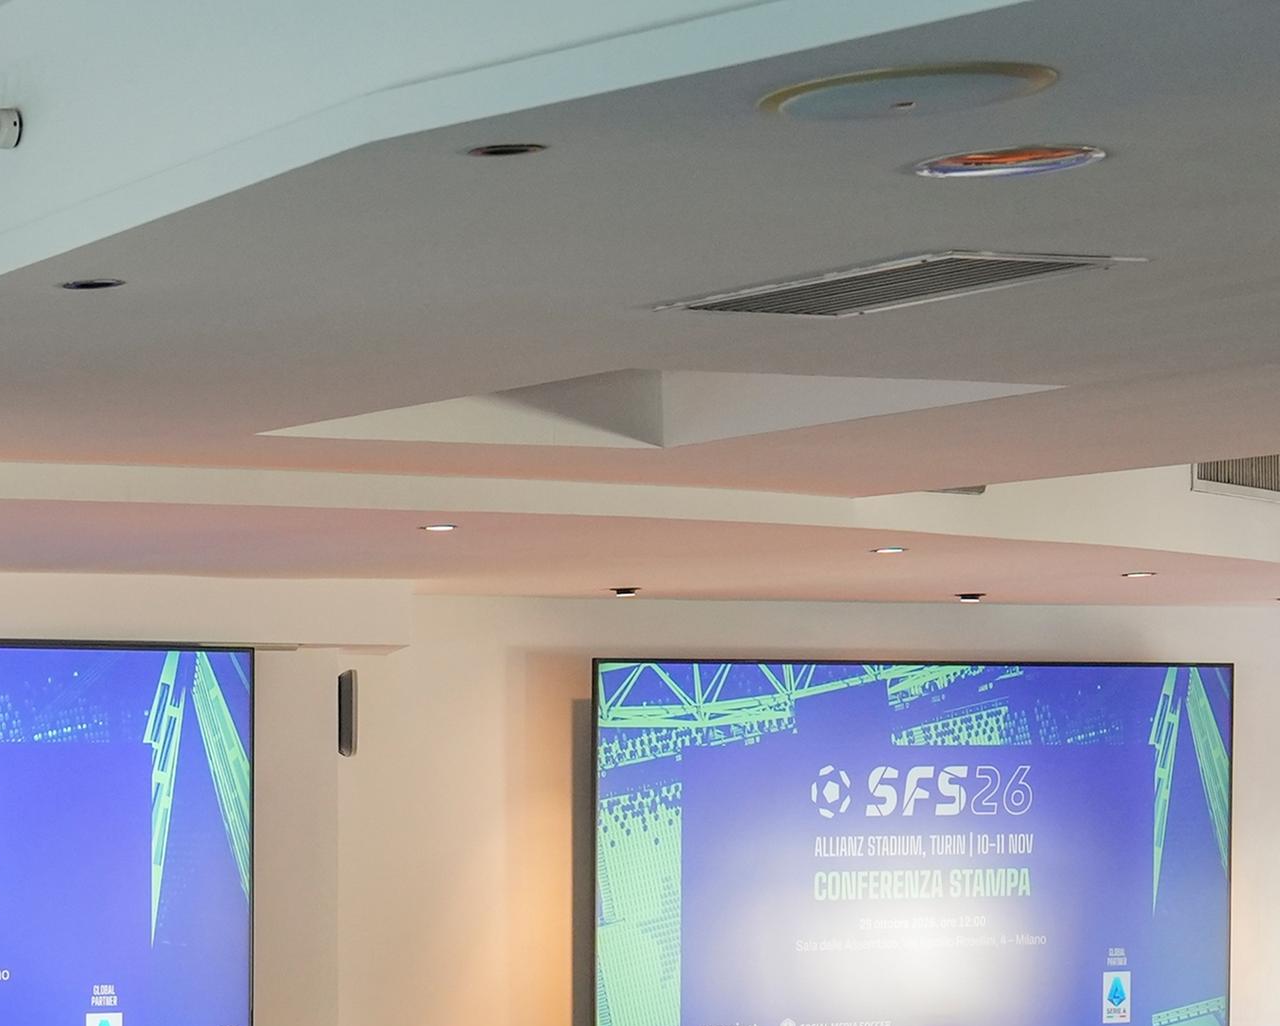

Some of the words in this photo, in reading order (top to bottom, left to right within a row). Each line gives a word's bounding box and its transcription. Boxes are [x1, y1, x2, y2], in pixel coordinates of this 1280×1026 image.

[865, 765, 1033, 816] SFS26
[815, 837, 864, 857] ALLIANZ
[868, 835, 926, 858] STADIUM,
[930, 834, 966, 855] TURIN
[1009, 834, 1034, 853] NOV
[814, 870, 943, 901] CONFERENZA
[949, 868, 1031, 897] STAMPA
[1016, 935, 1047, 944] Milano
